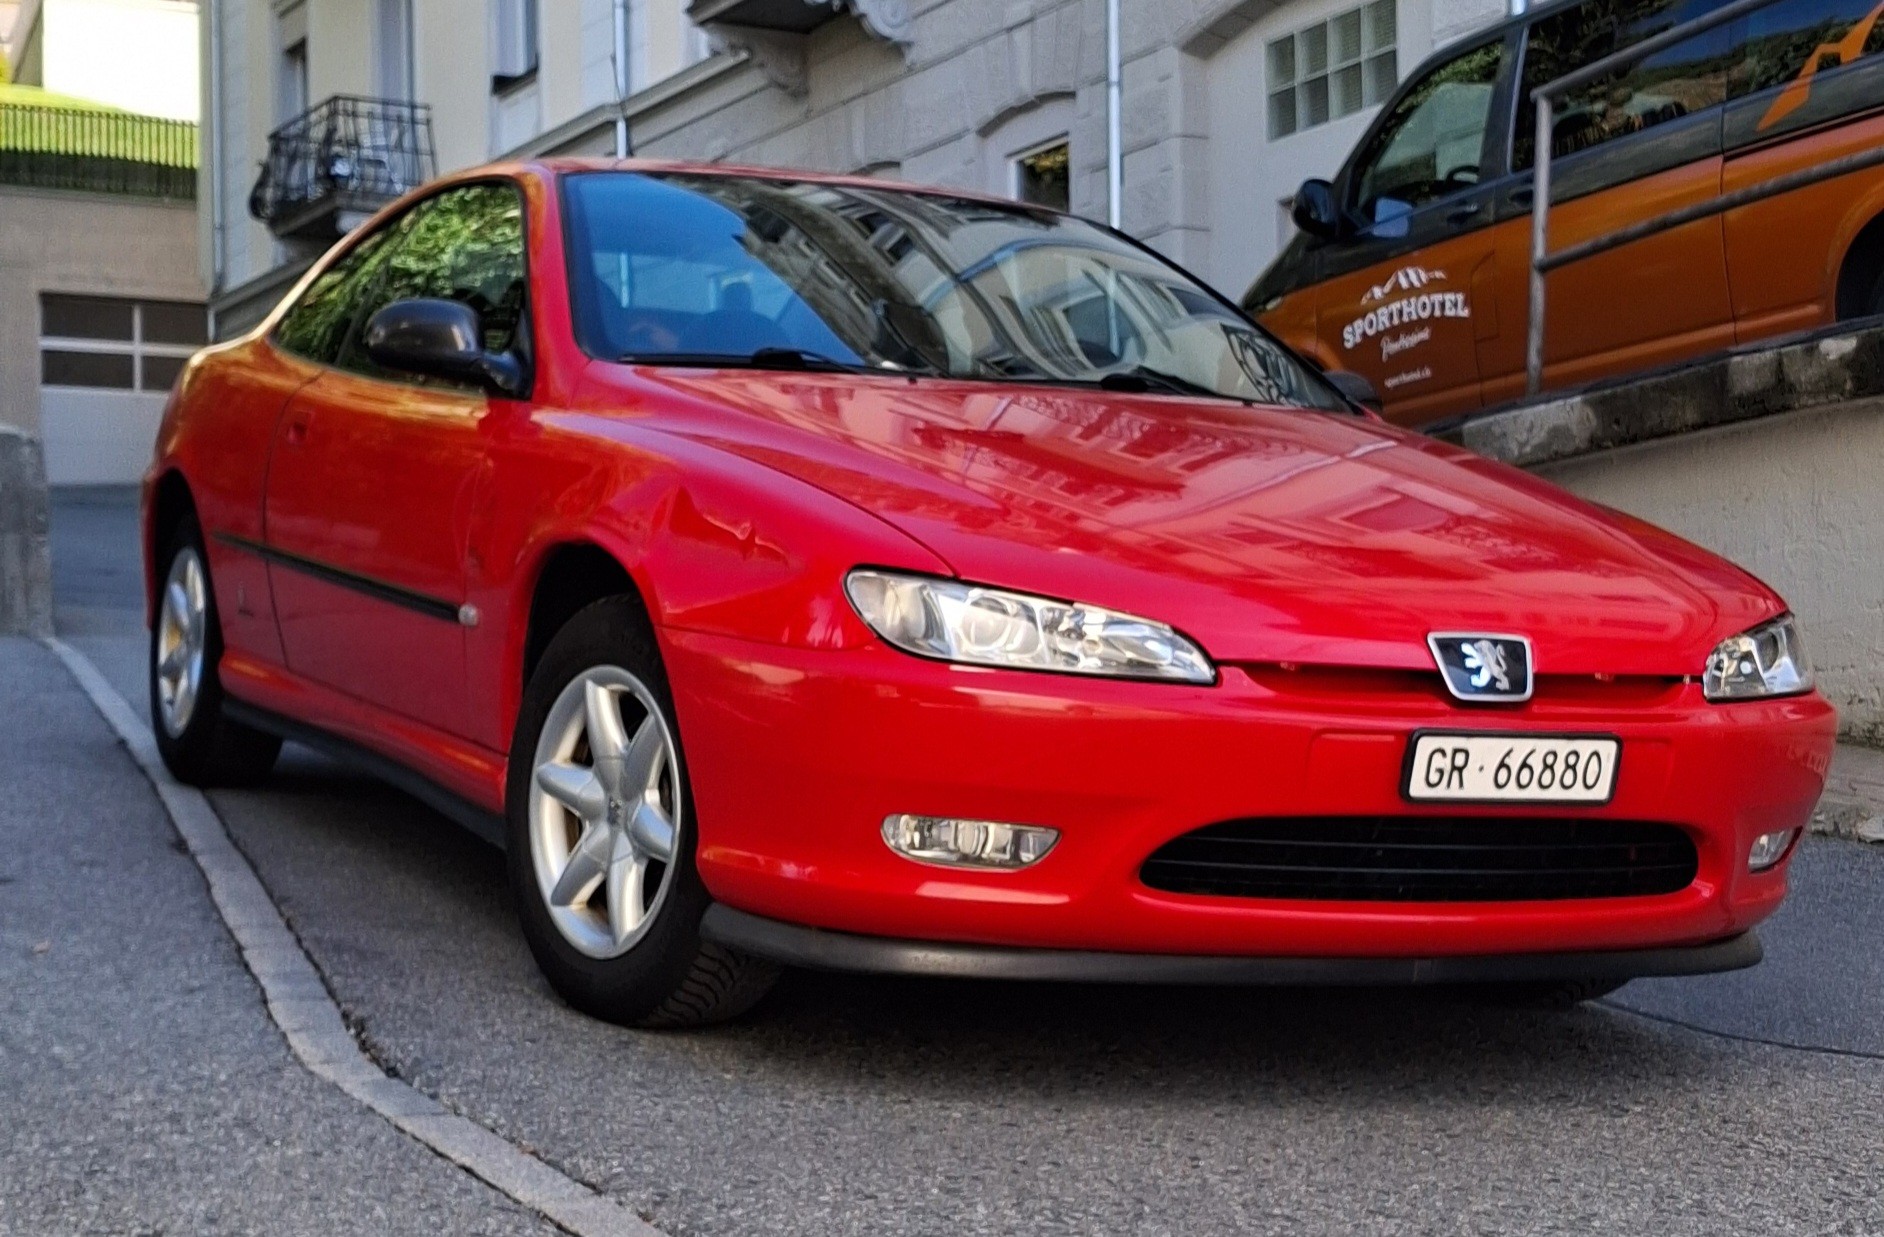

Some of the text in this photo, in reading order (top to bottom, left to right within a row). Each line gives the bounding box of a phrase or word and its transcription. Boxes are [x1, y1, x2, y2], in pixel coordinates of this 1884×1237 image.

[1342, 292, 1471, 349] SPORTHOTEL
[1424, 747, 1470, 790] GR
[1493, 747, 1602, 791] 66880
